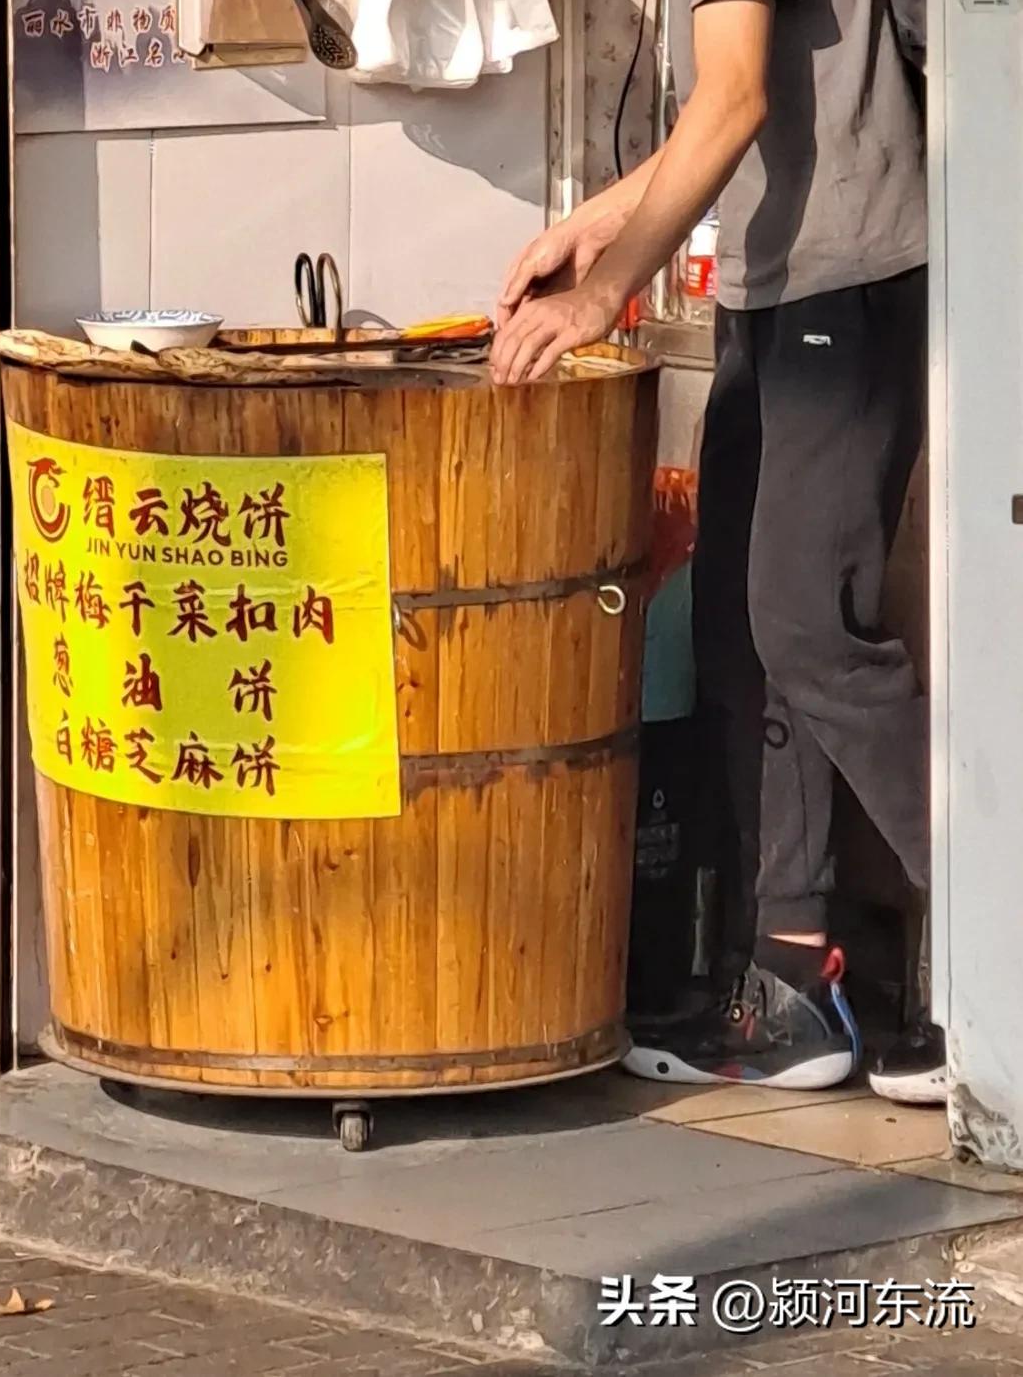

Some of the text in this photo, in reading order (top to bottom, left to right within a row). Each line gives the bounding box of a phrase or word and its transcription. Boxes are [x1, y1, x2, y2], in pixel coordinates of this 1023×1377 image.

[83, 475, 291, 547] 缙云烧饼
[87, 537, 288, 567] JIN YUN SHAO BING
[24, 549, 335, 645] 招牌梅干菜扣肉
[56, 710, 280, 796] 白糖芝麻饼
